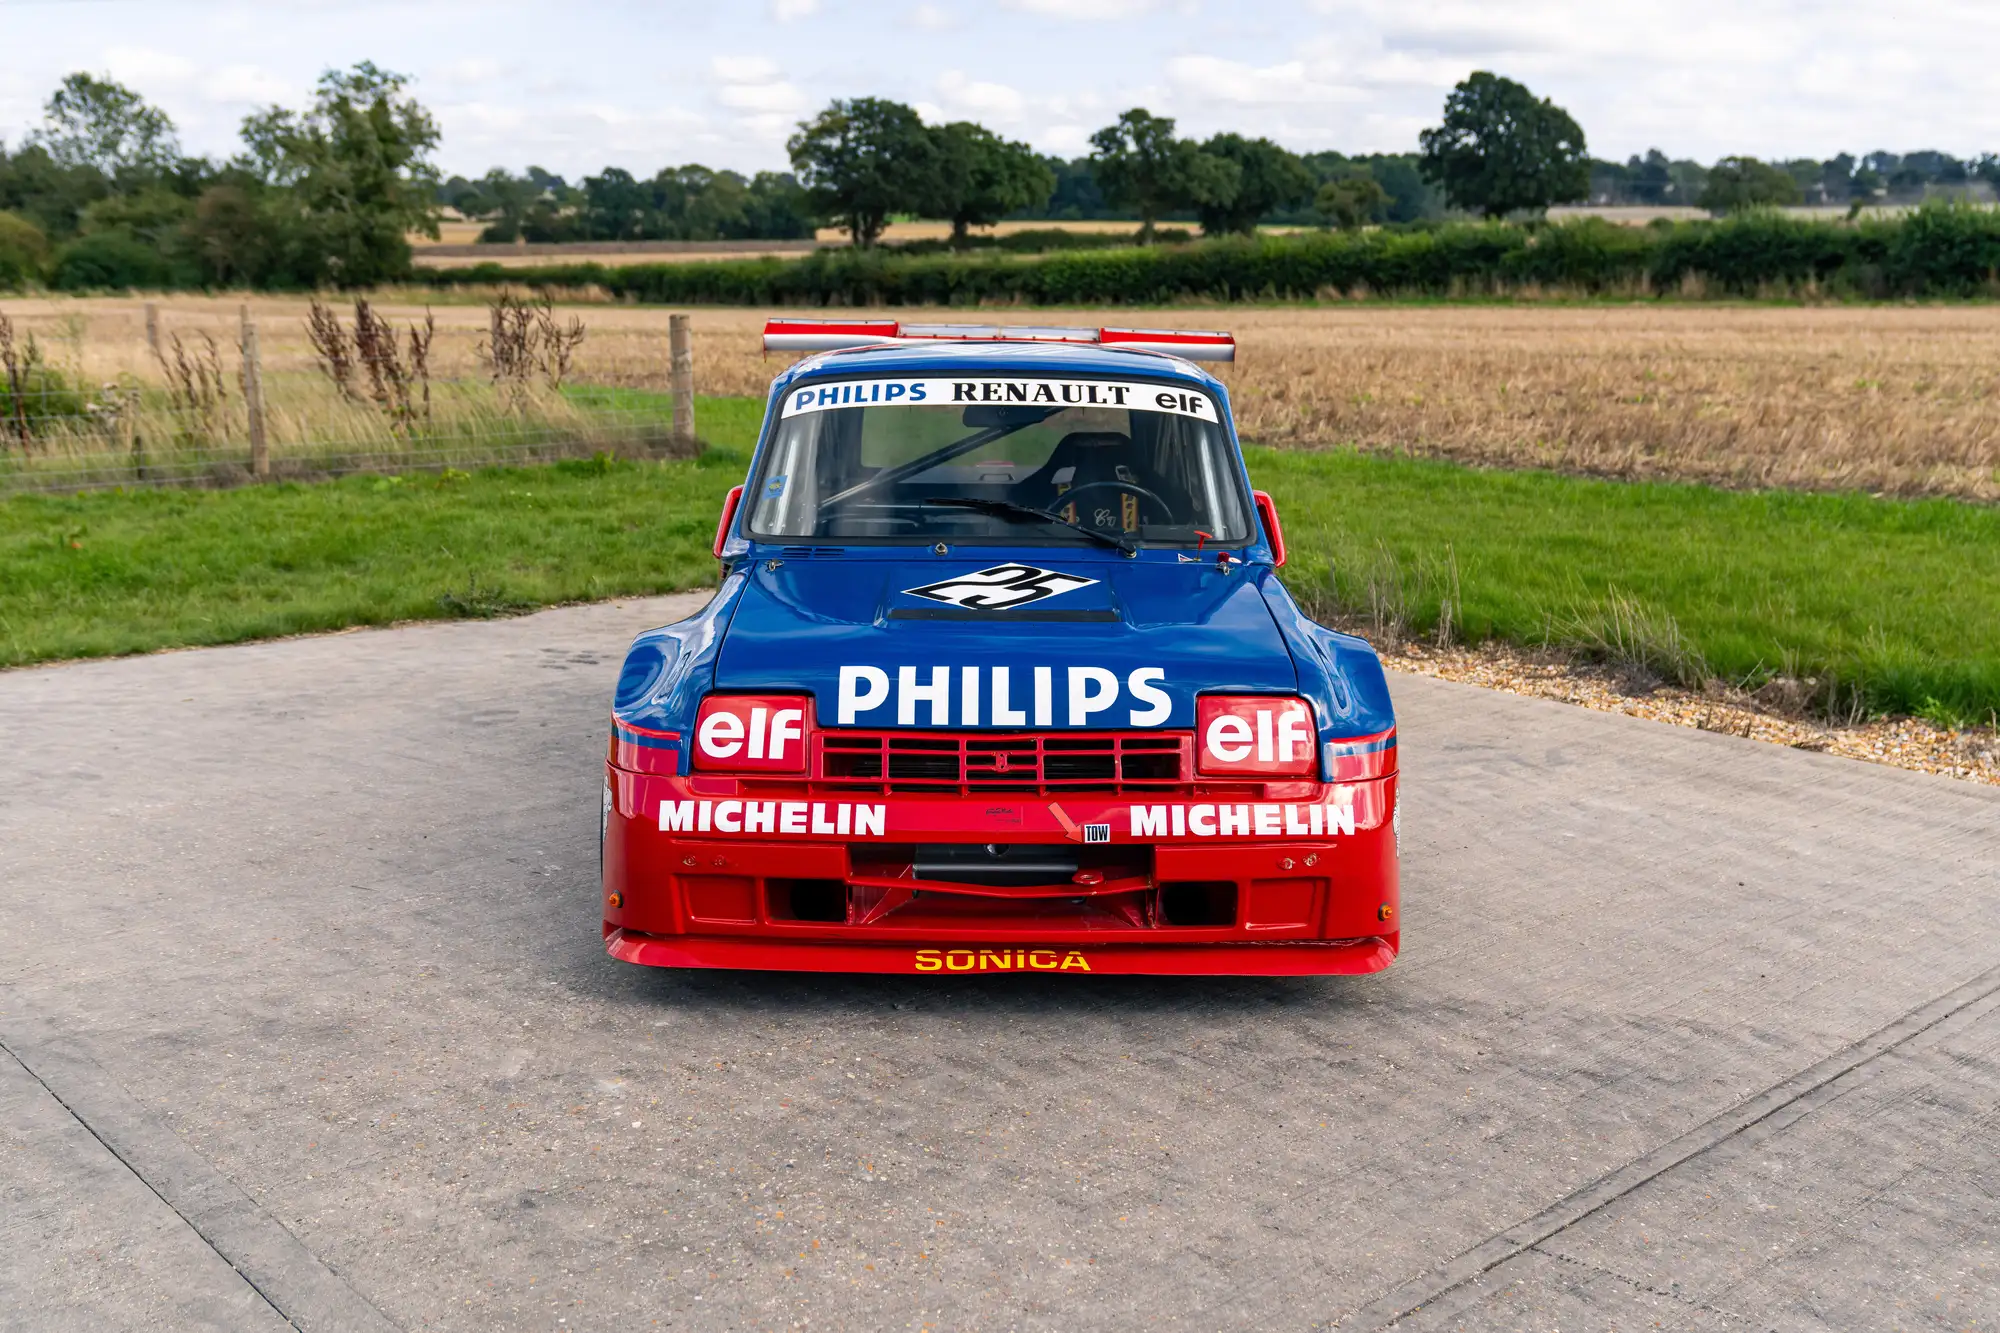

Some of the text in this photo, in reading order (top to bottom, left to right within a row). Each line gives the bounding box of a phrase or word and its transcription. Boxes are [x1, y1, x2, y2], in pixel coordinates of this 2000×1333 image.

[796, 383, 1203, 413] PHILIPS RENAULT elf
[837, 665, 1172, 727] PHILIPS
[698, 708, 802, 759] elf
[1206, 709, 1308, 763] elf
[658, 800, 886, 836] MICHELIN
[1086, 825, 1108, 841] TOW
[1130, 804, 1355, 836] MICHELIN
[915, 949, 1091, 971] SONICA
